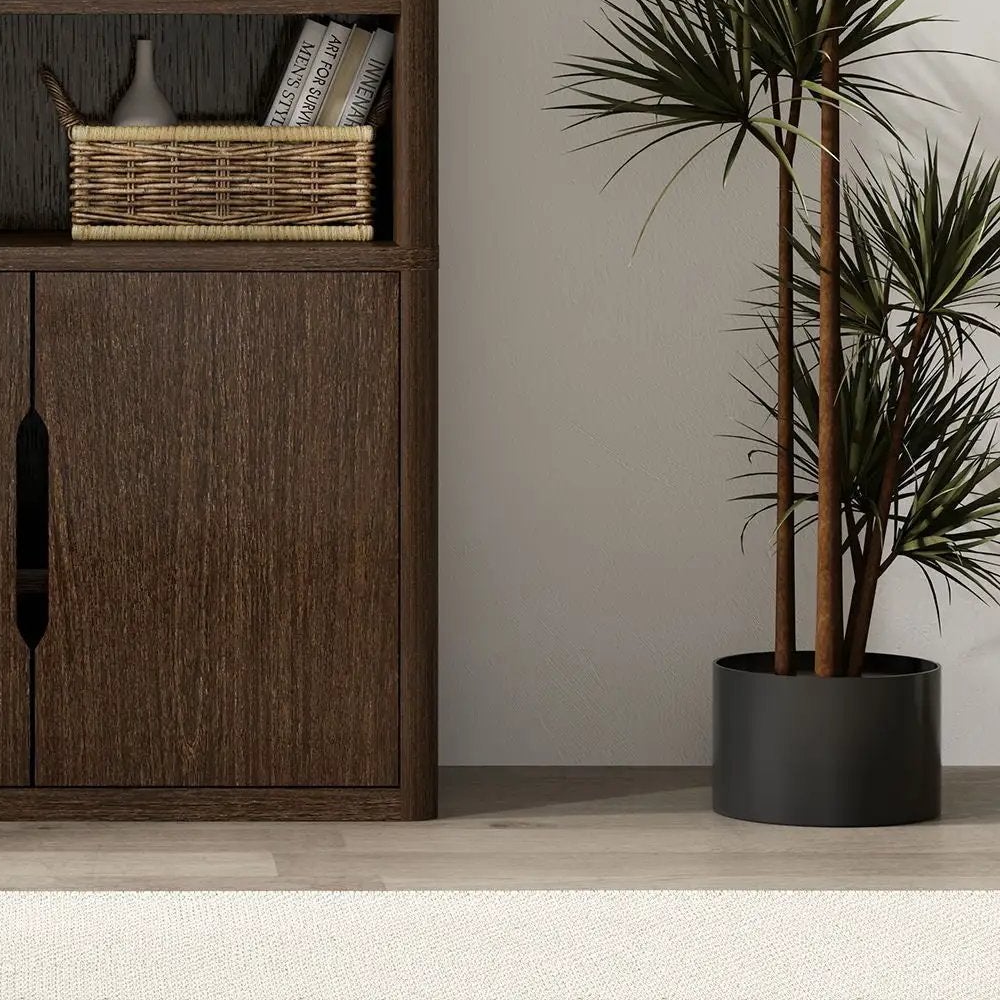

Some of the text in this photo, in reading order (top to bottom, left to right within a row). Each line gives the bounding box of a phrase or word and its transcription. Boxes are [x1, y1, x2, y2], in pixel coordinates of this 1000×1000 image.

[324, 34, 342, 60] ART
[287, 41, 315, 89] MEN'S
[312, 60, 333, 86] FOR
